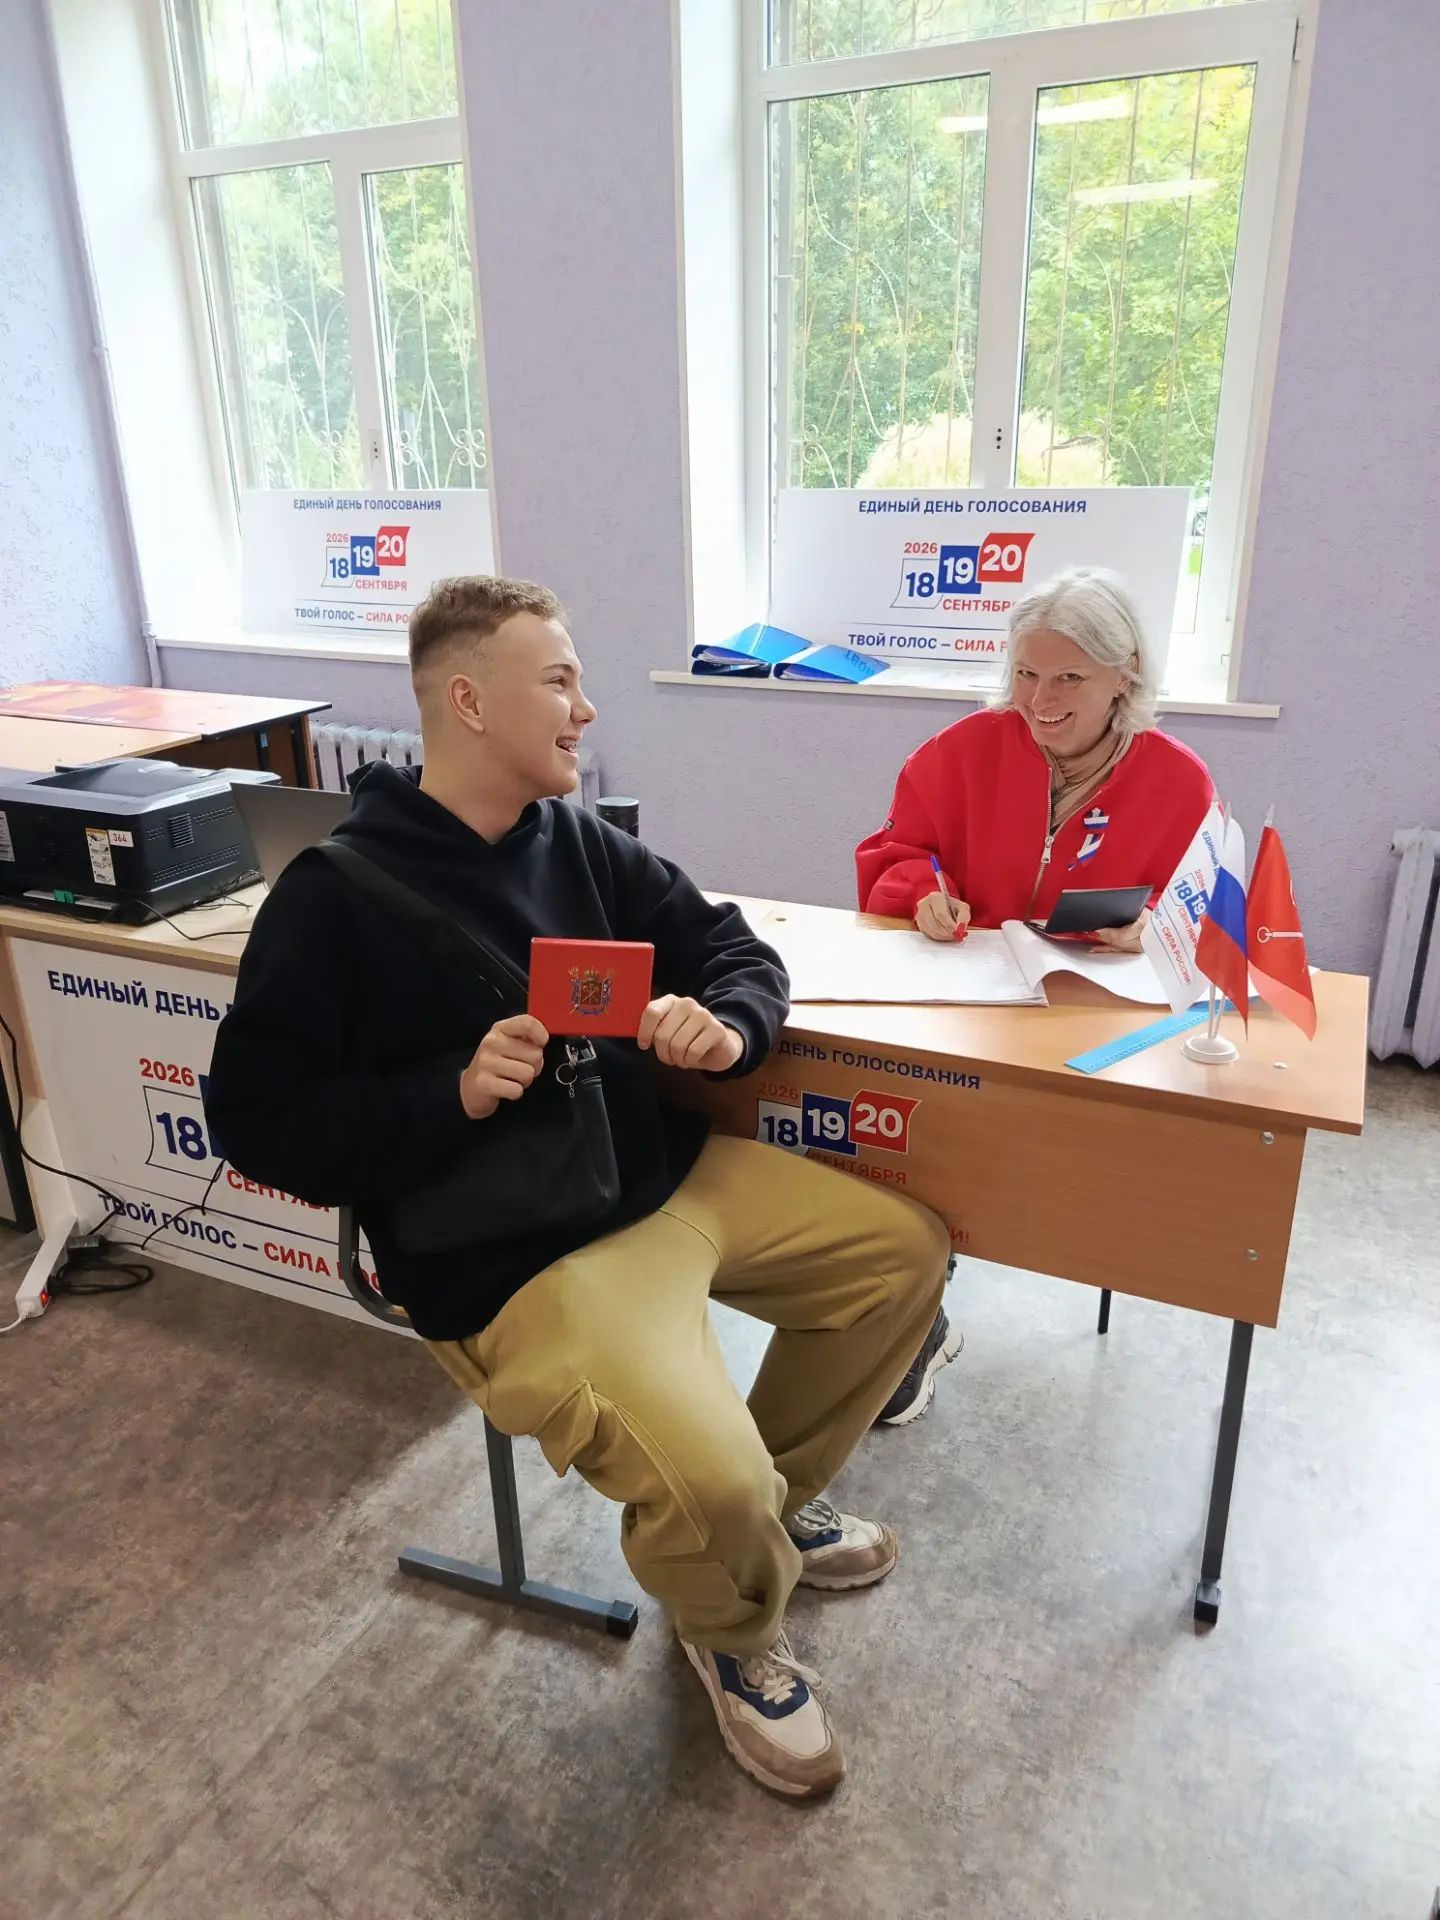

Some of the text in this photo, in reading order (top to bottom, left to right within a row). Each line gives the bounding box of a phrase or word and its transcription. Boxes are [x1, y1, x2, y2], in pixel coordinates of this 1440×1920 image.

[293, 497, 442, 511] ЕДИНЫЙ ДЕНЬ ГОЛОСОВАНИЯ
[858, 498, 1087, 516] ЕДИНЫЙ ДЕНЬ ГОЛОСОВАНИЯ
[326, 533, 349, 543] 2026
[903, 541, 938, 554] 2026
[329, 534, 404, 579] 18 19 20
[905, 544, 1022, 598] 18 19 20
[355, 579, 408, 591] СЕНТЯБРЯ
[295, 607, 320, 619] ТВОЙ
[323, 609, 355, 621] ГОЛОС
[366, 612, 393, 623] СИЛА
[942, 598, 1015, 612] СЕНТЯБР
[849, 633, 886, 647] ТВОЙ
[889, 636, 937, 649] ГОЛОС
[954, 639, 995, 652] СИЛА
[113, 833, 127, 843] 364
[1194, 868, 1206, 889] 2026
[1174, 879, 1207, 916] 18 19
[1161, 926, 1177, 950] СИЛА
[1179, 906, 1199, 949] СЕНТЯБР
[47, 970, 220, 1021] ЕДИНЫЙ ДЕНЬ
[138, 1058, 195, 1087] 2026
[779, 1040, 980, 1090] ДЕНЬ ГОЛОСОВАНИЯ
[758, 1081, 798, 1100] 2026
[763, 1102, 904, 1147] 18 19 20
[155, 1112, 208, 1161] 18
[98, 1193, 157, 1227] ТВОЙ
[161, 1212, 237, 1249] ГОЛОС
[263, 1242, 331, 1277] СИЛА
